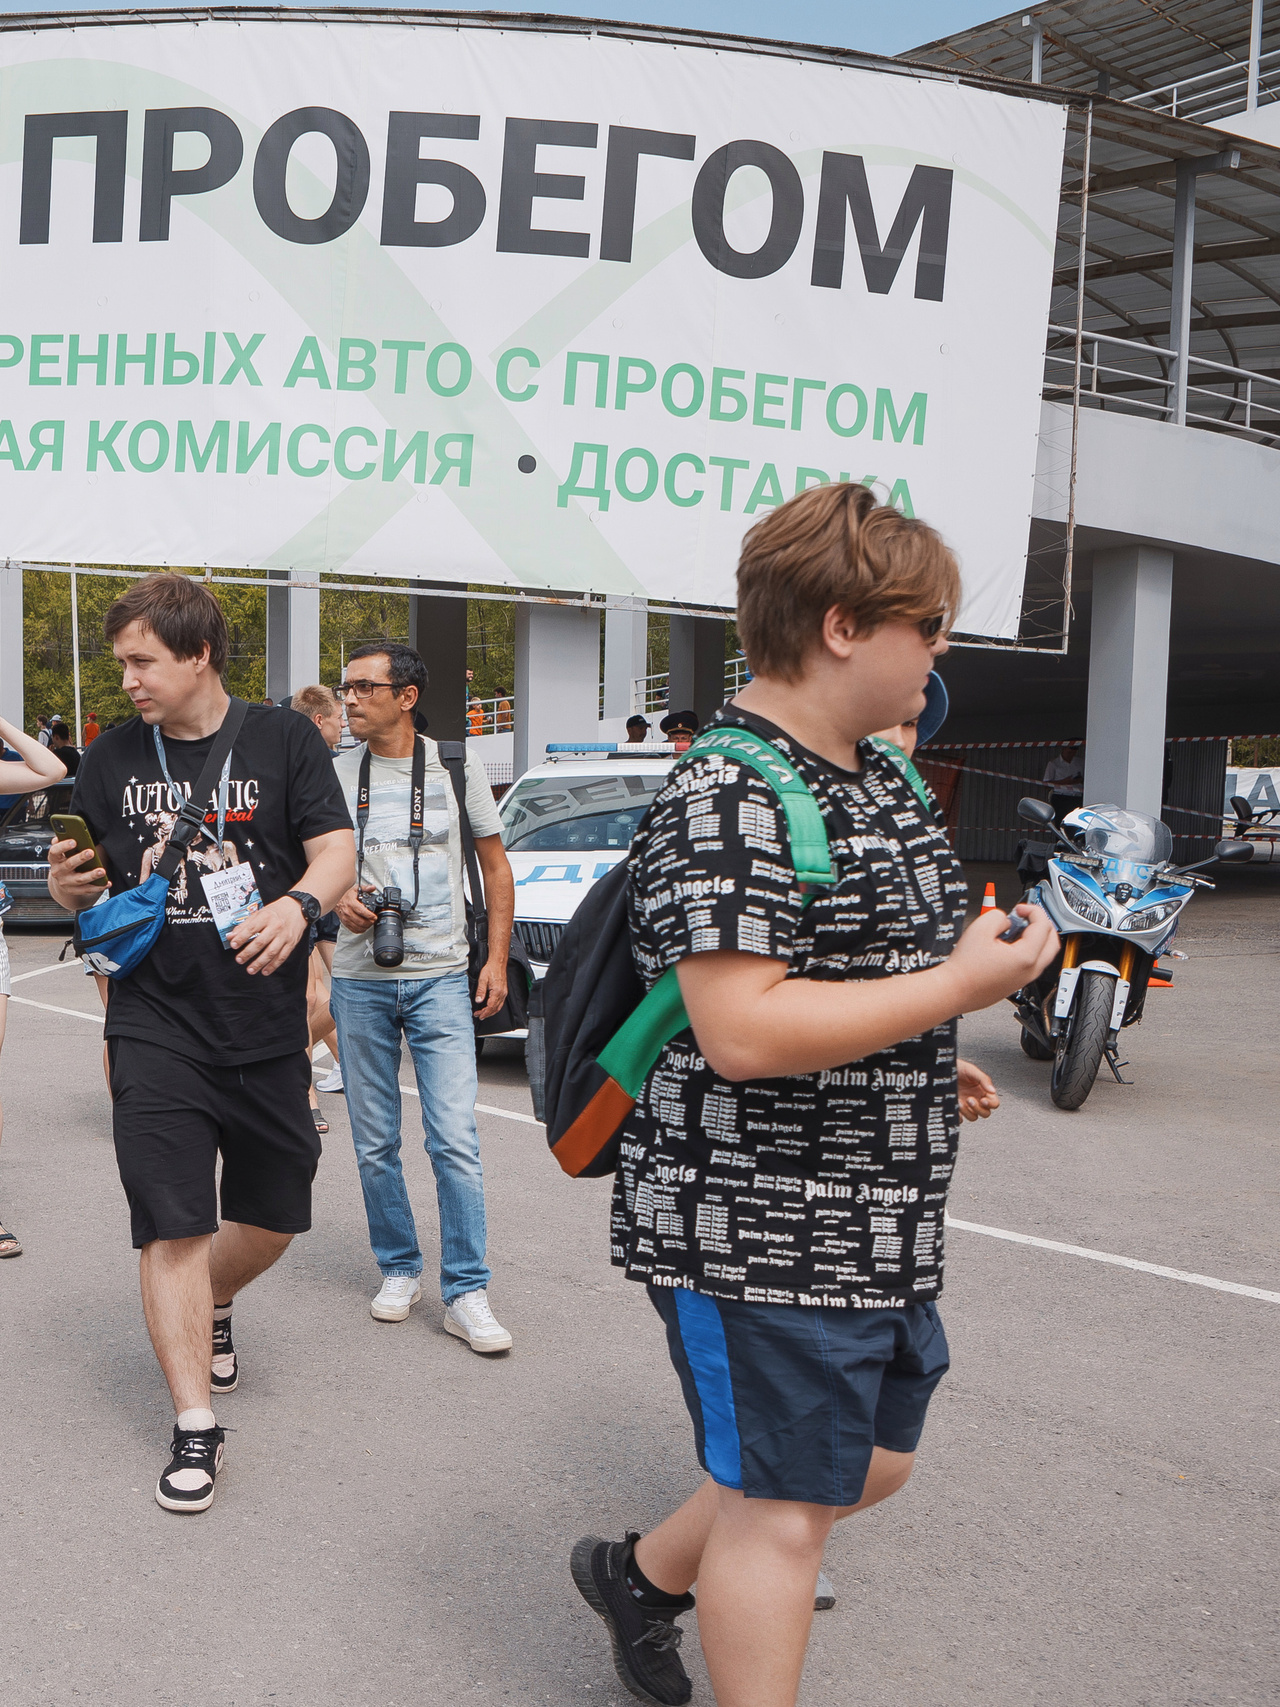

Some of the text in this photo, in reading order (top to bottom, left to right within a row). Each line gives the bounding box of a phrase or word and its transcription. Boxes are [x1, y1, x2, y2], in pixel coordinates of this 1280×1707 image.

[20, 107, 953, 302] ПРОБЕГОМ
[283, 336, 472, 397] АВТО
[496, 347, 540, 402] С
[563, 352, 927, 445] ПРОБЕГОМ
[86, 420, 474, 487] КОМИССИЯ
[413, 786, 422, 820] SONY
[364, 842, 398, 856] REEDOM
[1102, 858, 1150, 880] ДПС
[166, 906, 186, 916] When
[171, 914, 214, 924] remembere
[667, 1052, 706, 1071] ngels
[817, 1067, 928, 1092] Palm Angels
[655, 1165, 698, 1184] ngels
[804, 1180, 919, 1207] Palm Angels
